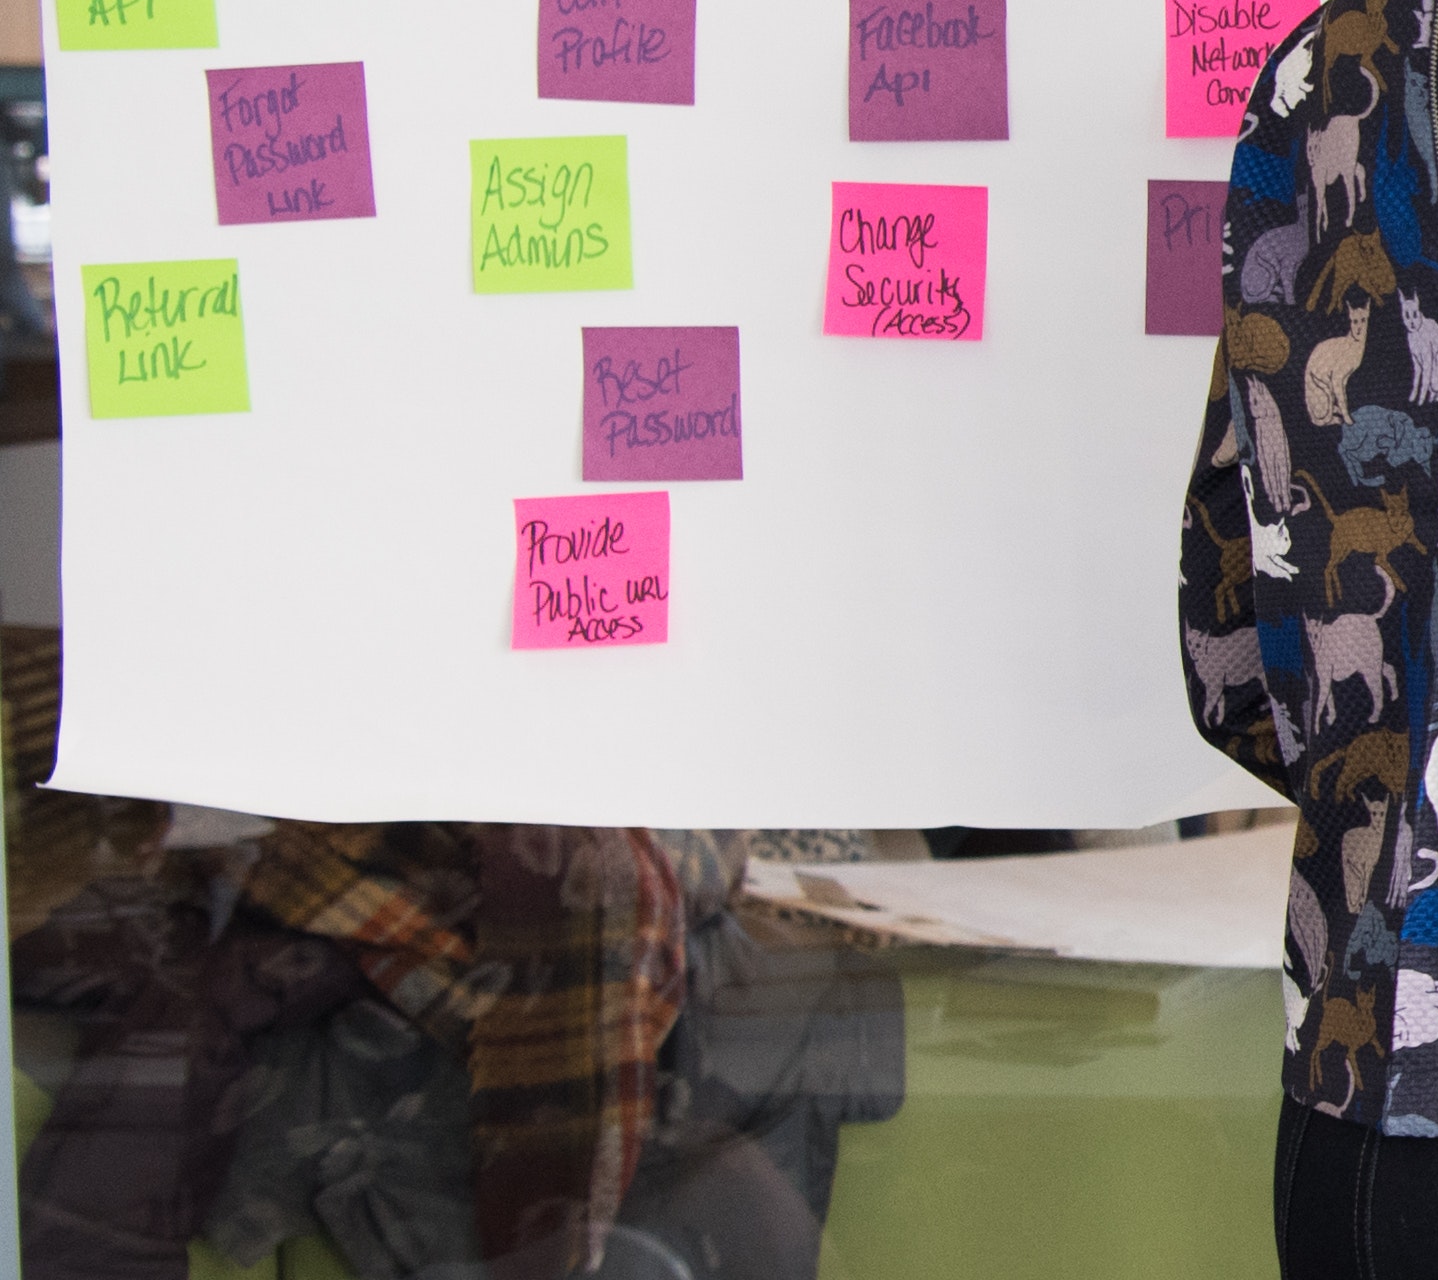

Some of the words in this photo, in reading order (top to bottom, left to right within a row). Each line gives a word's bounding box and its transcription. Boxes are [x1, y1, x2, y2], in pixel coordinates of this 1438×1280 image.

[552, 18, 672, 74] Profile
[218, 72, 307, 141] Forgot
[223, 114, 349, 187] Password
[267, 178, 336, 217] Link
[483, 155, 595, 229] Assign
[479, 220, 610, 271] Admins
[839, 208, 939, 269] Change
[92, 273, 239, 342] Referral
[841, 264, 964, 313] Security
[118, 331, 208, 385] Link
[592, 348, 693, 410] Reset
[600, 391, 739, 458] Password
[521, 516, 630, 579] Provide
[530, 574, 619, 628] Public
